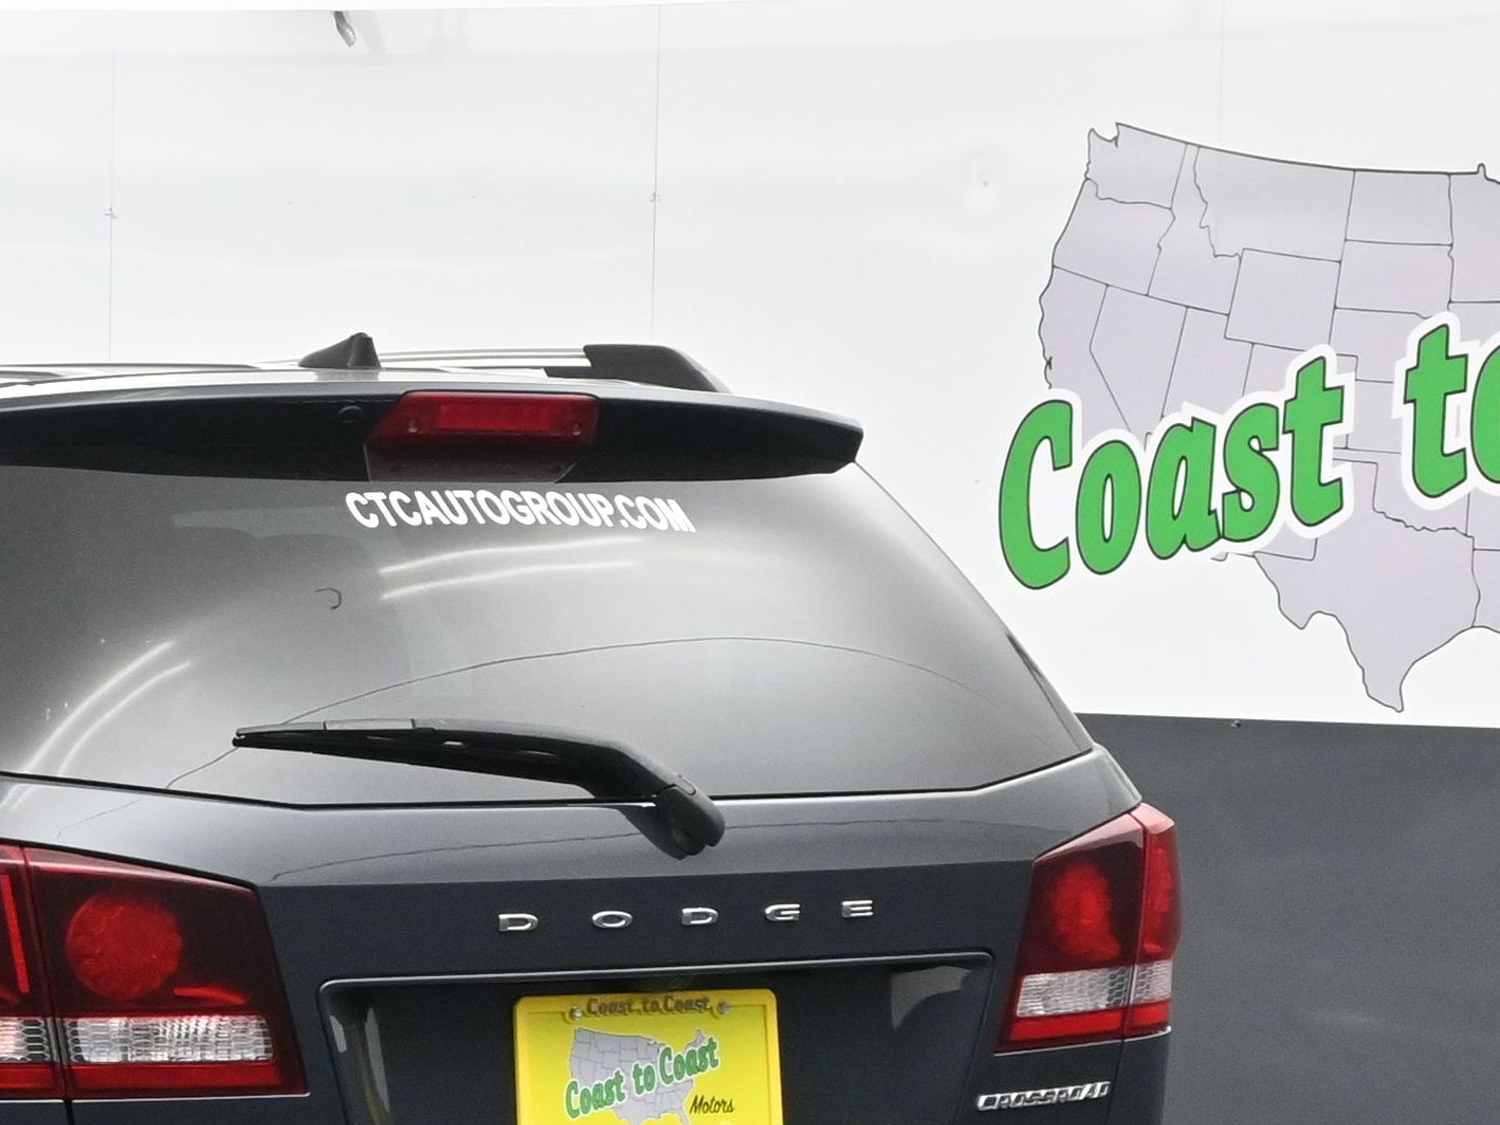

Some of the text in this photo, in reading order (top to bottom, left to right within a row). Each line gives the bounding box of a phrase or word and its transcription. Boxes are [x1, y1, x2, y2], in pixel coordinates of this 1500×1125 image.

[999, 355, 1345, 590] Coast
[345, 489, 697, 533] CTCAUTOGROUP.COM
[498, 899, 875, 932] DODGE
[564, 1036, 719, 1119] Coast to Coast
[689, 1094, 735, 1115] Motors
